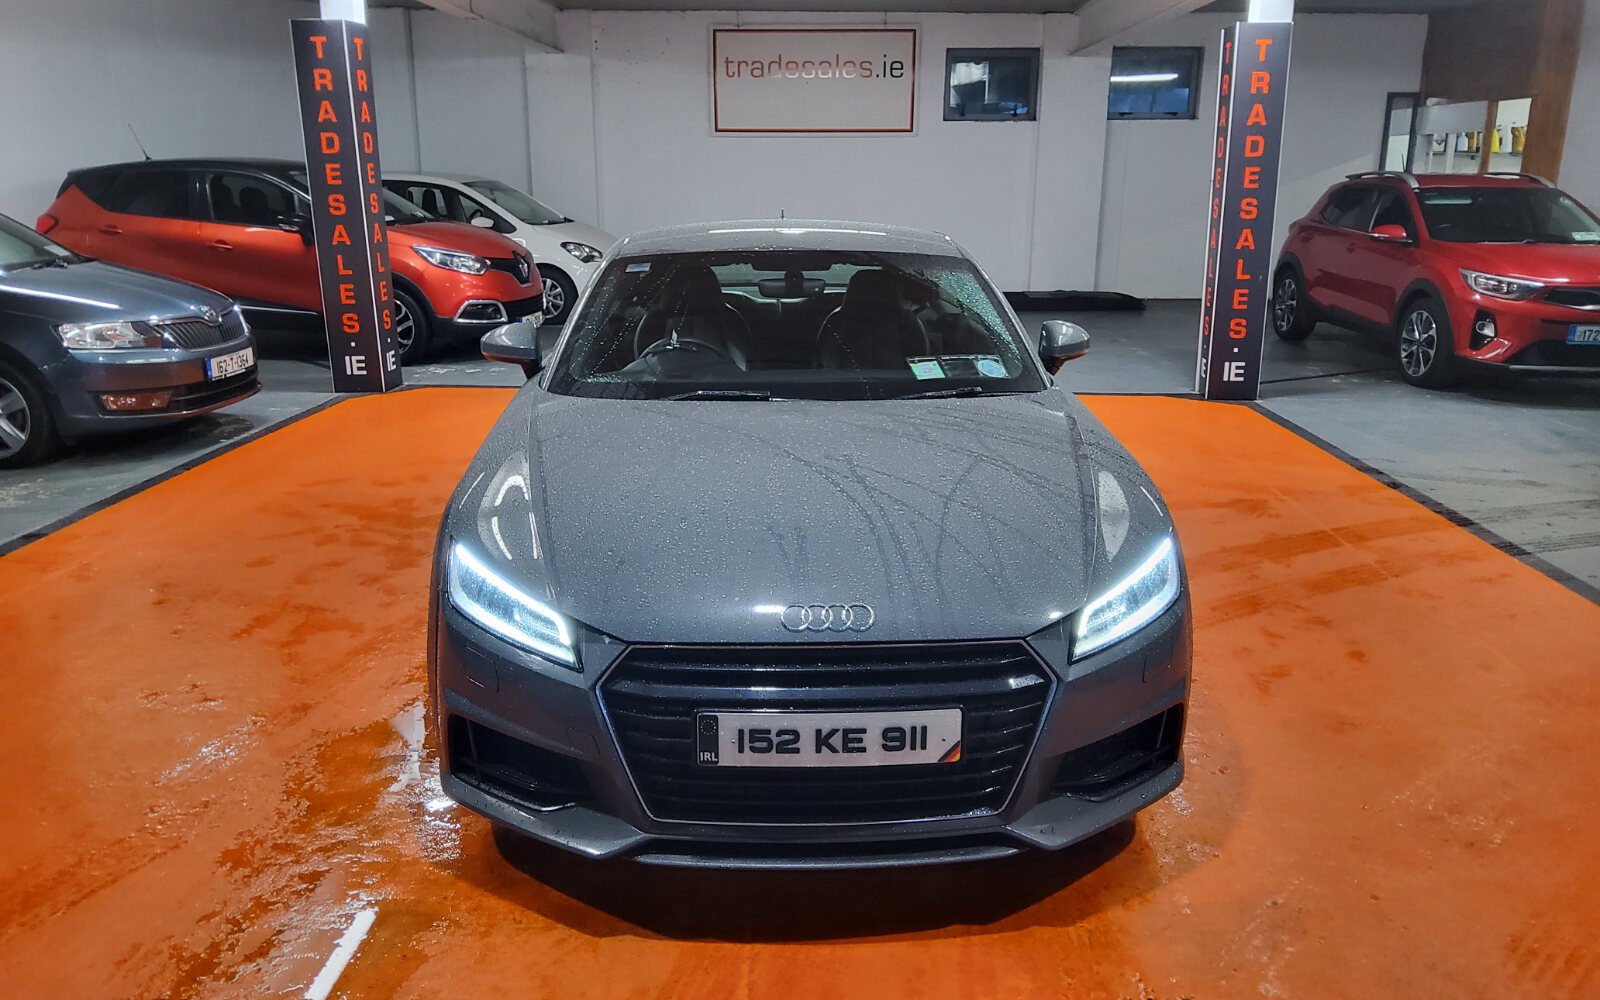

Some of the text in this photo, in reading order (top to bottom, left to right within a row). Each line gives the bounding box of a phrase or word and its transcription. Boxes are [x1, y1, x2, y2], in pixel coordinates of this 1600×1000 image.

[724, 54, 904, 78] tradesales.ie
[738, 726, 928, 754] 152 KE 911
[700, 751, 718, 762] IRL
